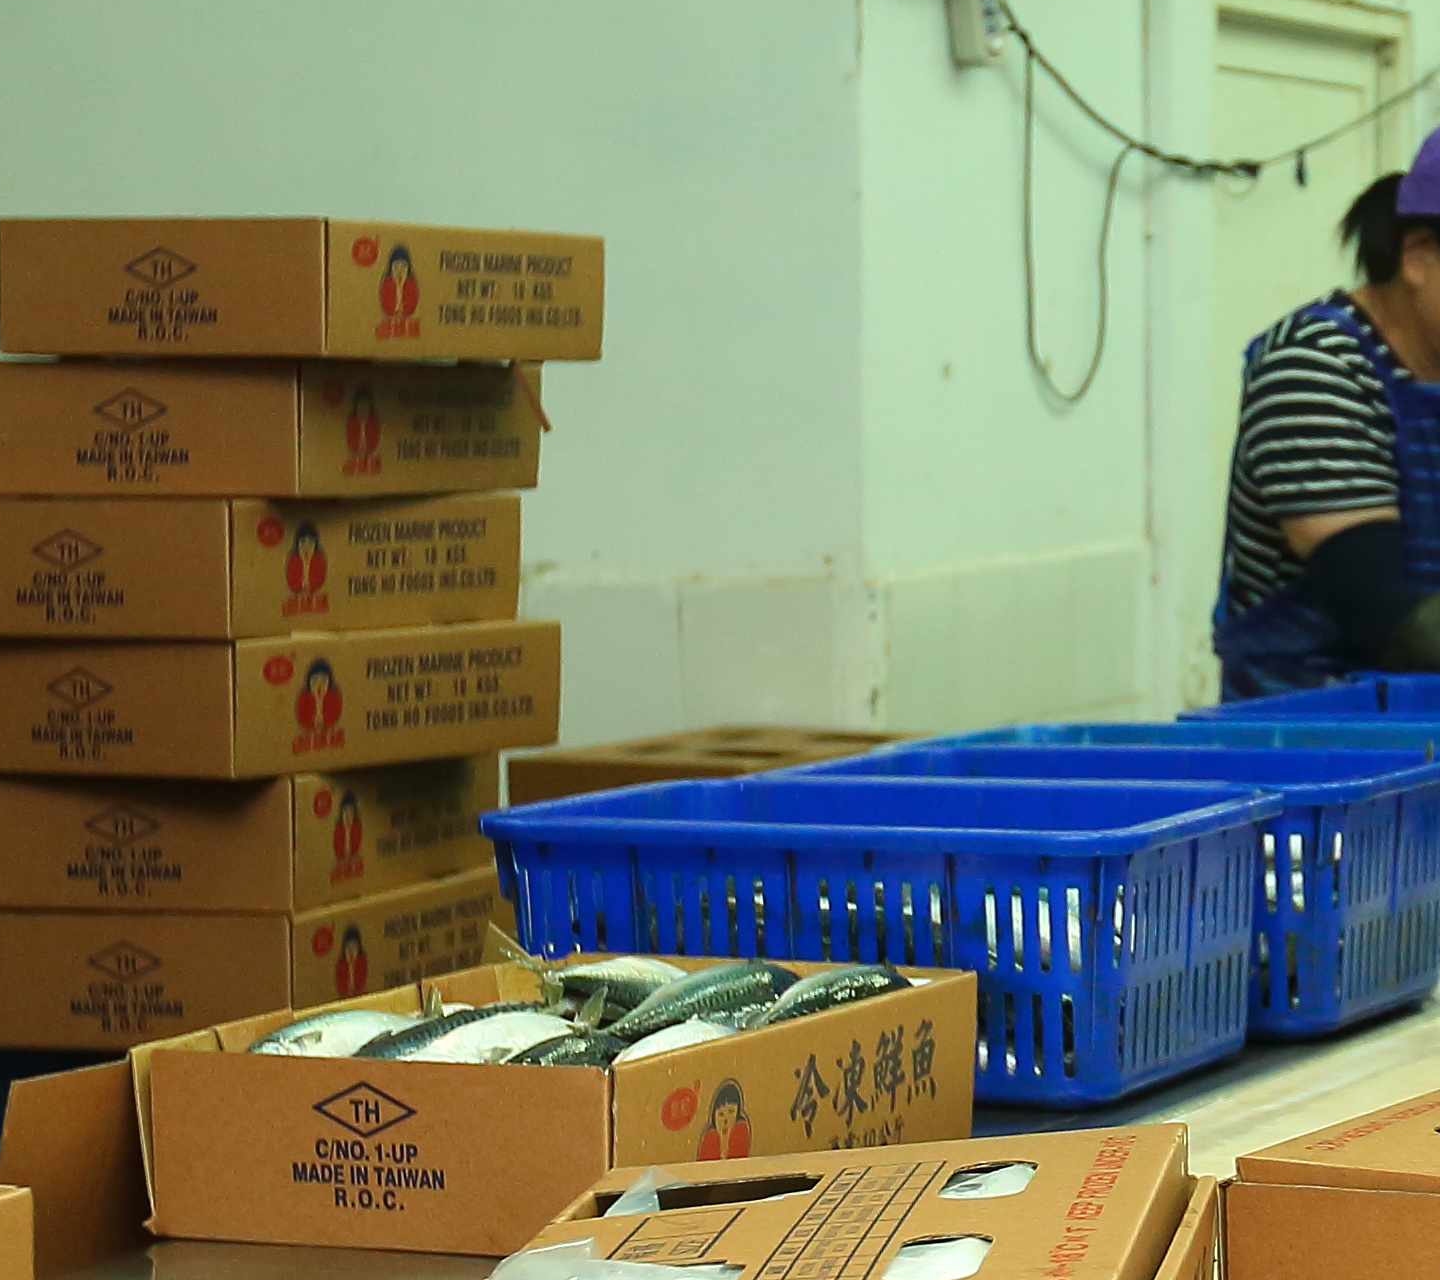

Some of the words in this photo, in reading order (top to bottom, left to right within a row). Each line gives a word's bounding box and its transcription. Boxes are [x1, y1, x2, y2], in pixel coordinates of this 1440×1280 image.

[151, 260, 174, 278] TH
[108, 308, 145, 323] MADE
[150, 308, 163, 323] IN
[167, 308, 219, 323] TAIWAN
[122, 401, 144, 419] TH
[76, 448, 113, 465] MADE
[119, 448, 133, 464] IN
[138, 448, 190, 464] TAIWAN
[60, 541, 80, 562] TH
[16, 588, 54, 605] MADE
[58, 589, 70, 605] IN
[76, 589, 125, 607] TAIWAN
[790, 1019, 937, 1140] 冷凍鮮魚
[349, 1101, 383, 1122] TH
[315, 1140, 369, 1161] C/NO.
[374, 1143, 418, 1163] 1-UP
[292, 1163, 345, 1185] MADE
[349, 1165, 369, 1186] IN
[373, 1166, 445, 1190] TAIWAN
[334, 1190, 404, 1212] R.O.C.
